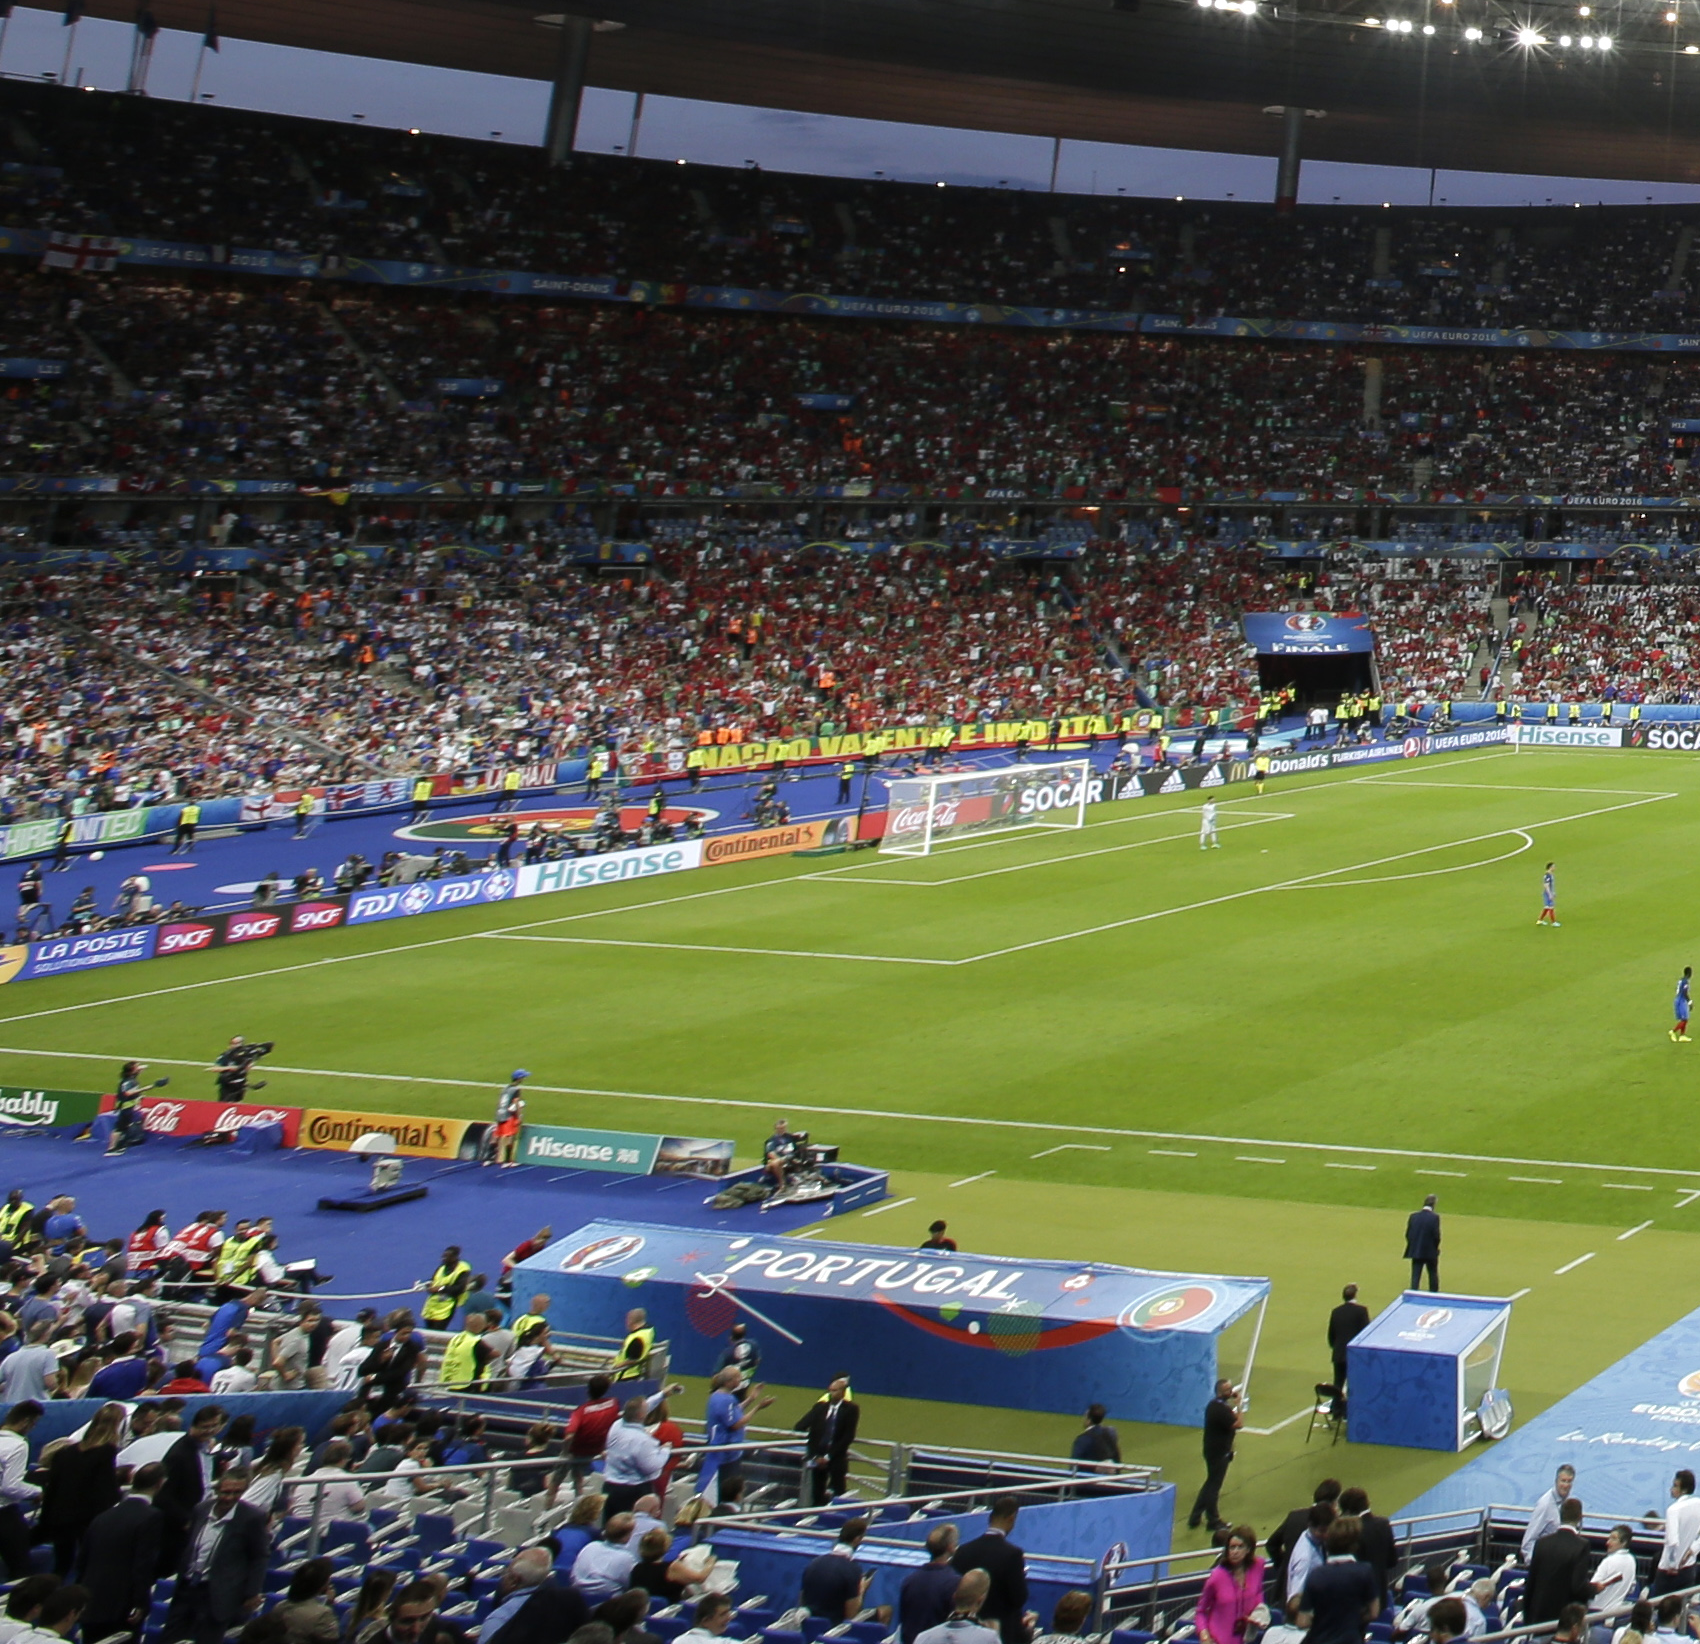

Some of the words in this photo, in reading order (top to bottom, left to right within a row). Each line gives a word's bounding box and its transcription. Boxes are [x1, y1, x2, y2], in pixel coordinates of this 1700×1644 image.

[137, 246, 175, 260] UEFA
[230, 252, 268, 267] 2016
[533, 278, 609, 294] SAINT-DENIS
[843, 301, 874, 312] UEFA
[876, 303, 911, 314] EURO
[914, 304, 942, 316] 2016
[1412, 330, 1439, 340] UEFA
[1441, 331, 1466, 341] EURO
[1468, 332, 1497, 342] 2016
[350, 483, 374, 493] 016
[1567, 496, 1591, 504] UEFA
[1593, 497, 1618, 505] EURO
[1619, 497, 1643, 505] 2016
[1272, 642, 1349, 653] FINALE
[959, 723, 977, 746] E
[1435, 735, 1460, 750] UEFA
[1461, 732, 1485, 746] EURO
[1486, 728, 1508, 743] 2016
[1518, 725, 1611, 745] Hisense
[1332, 751, 1367, 764] TURKISH
[1368, 744, 1404, 759] AIRLINES
[1159, 784, 1186, 794] adidas
[1200, 777, 1226, 788] adidas
[1019, 778, 1104, 816] SOCAR
[1118, 789, 1145, 800] adidas
[72, 809, 142, 842] NITED
[705, 826, 801, 862] Continental
[536, 848, 684, 892] Hisense
[437, 879, 483, 906] FDJ
[351, 893, 399, 920] FDJ
[291, 906, 344, 931] SNCF
[159, 927, 216, 951] SNCF
[225, 917, 281, 943] SNCF
[37, 940, 71, 961] LA
[76, 929, 149, 953] POSTE
[527, 1135, 614, 1163] Hisense
[726, 1246, 1025, 1301] PORTUGAL
